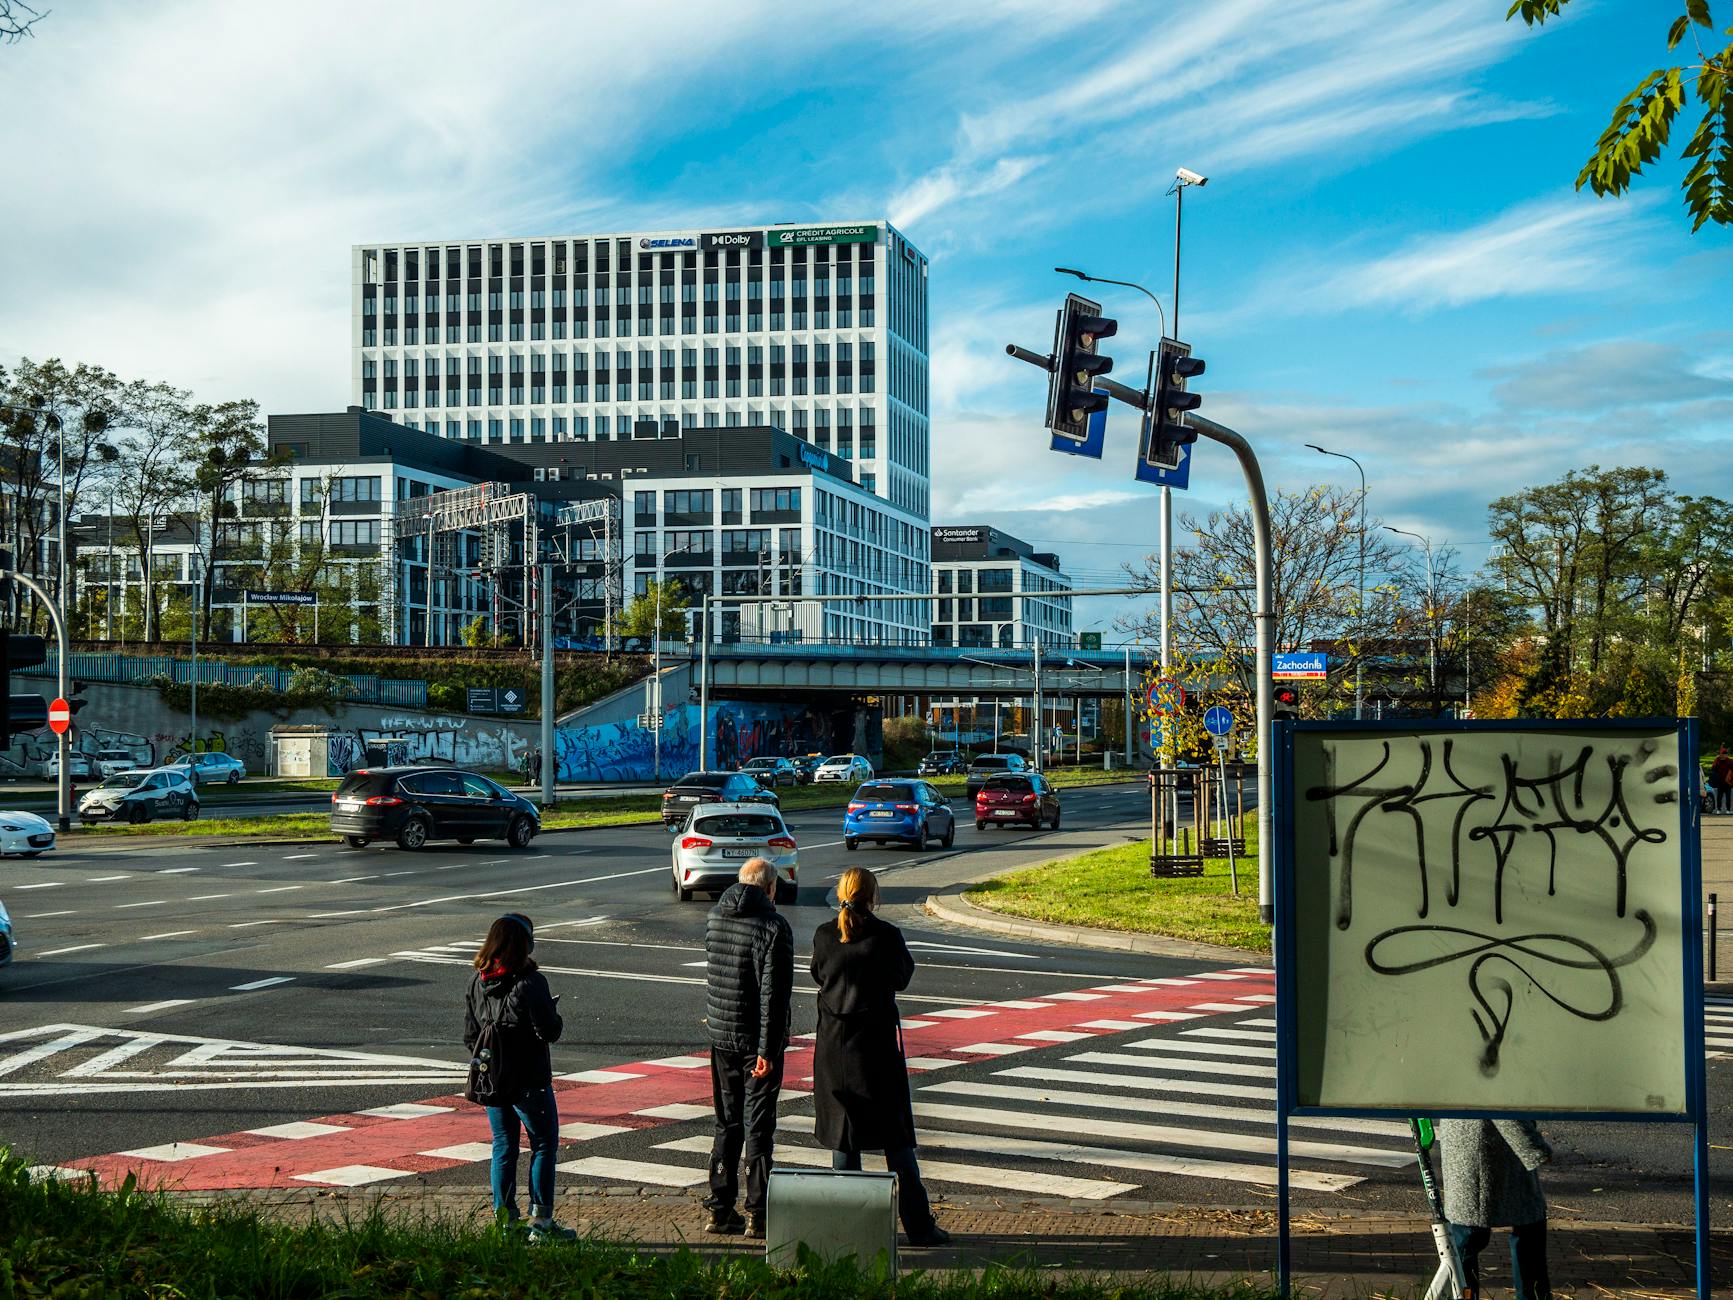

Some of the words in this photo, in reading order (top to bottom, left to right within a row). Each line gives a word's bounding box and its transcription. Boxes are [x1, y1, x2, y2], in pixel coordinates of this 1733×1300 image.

[796, 229, 825, 238] CRÉDIT
[825, 227, 865, 237] AGRICOLE
[650, 238, 694, 248] SELENA
[725, 234, 751, 246] Dolby
[943, 529, 979, 537] Santander
[1277, 660, 1322, 670] Zachodnia
